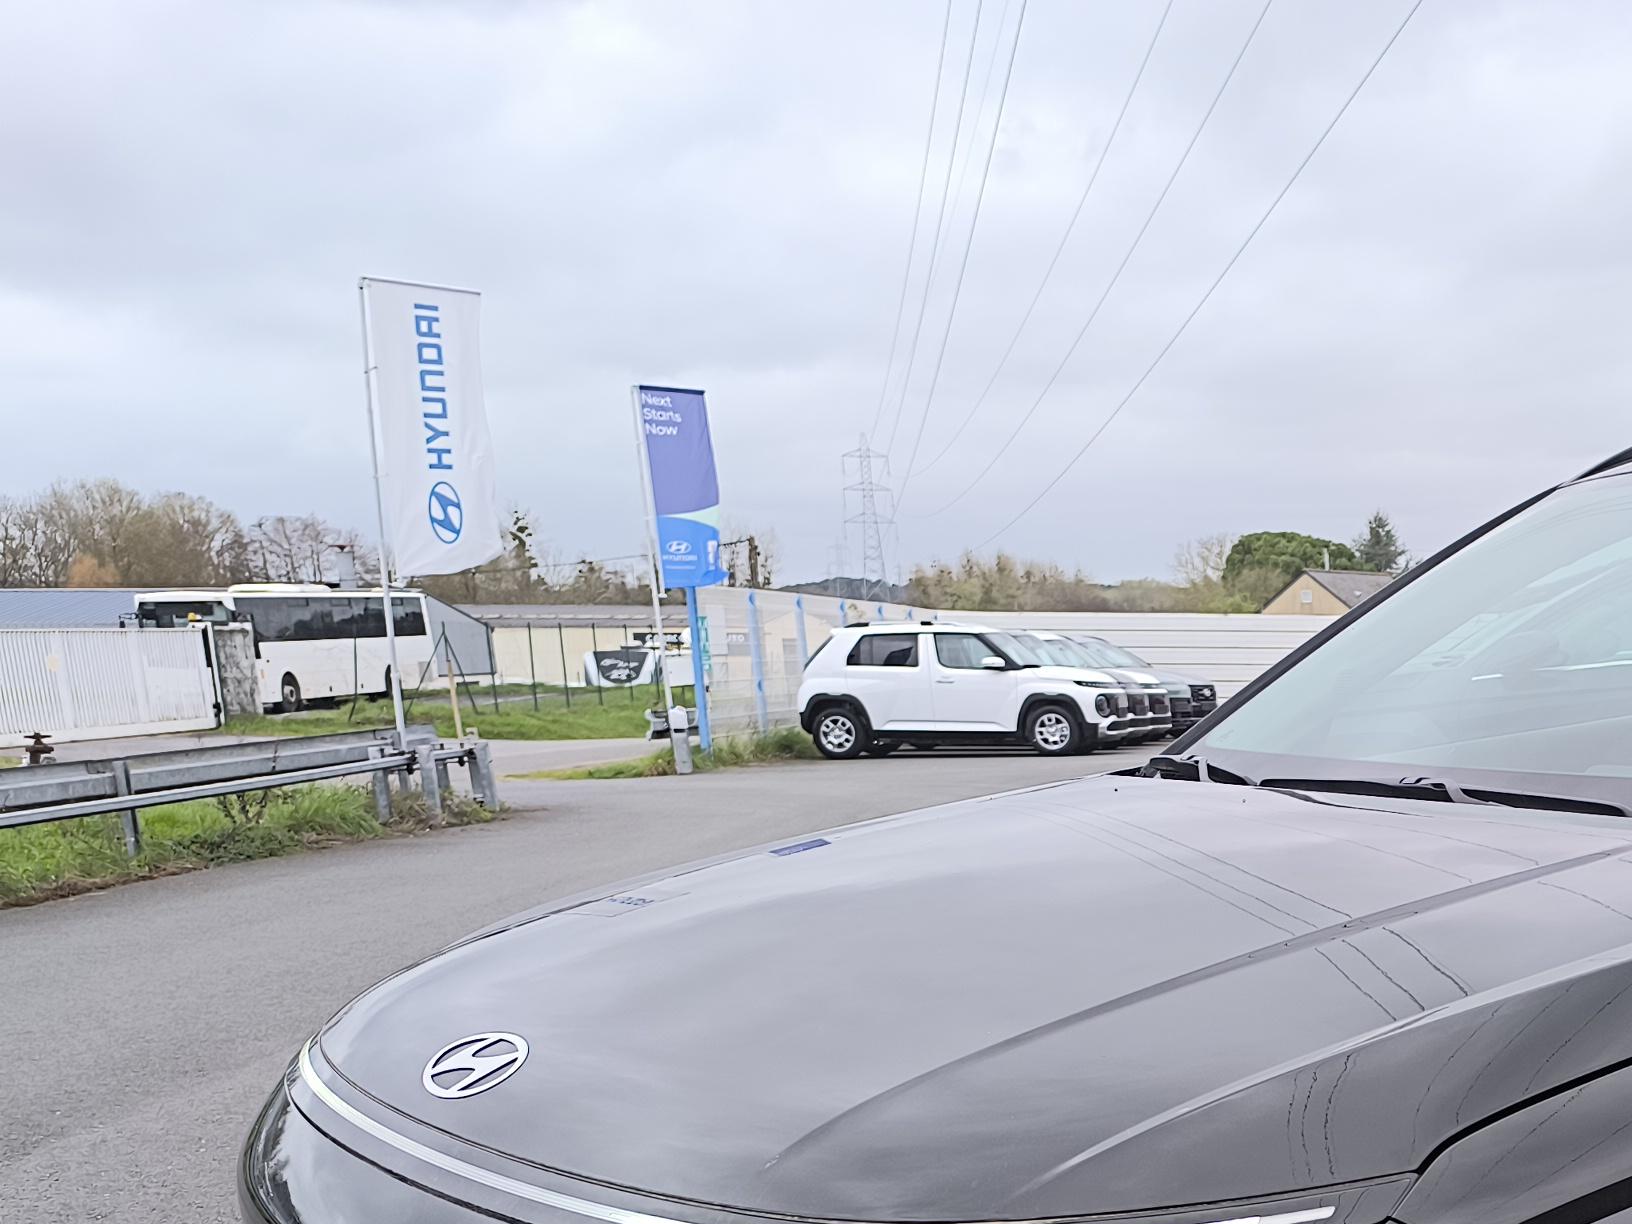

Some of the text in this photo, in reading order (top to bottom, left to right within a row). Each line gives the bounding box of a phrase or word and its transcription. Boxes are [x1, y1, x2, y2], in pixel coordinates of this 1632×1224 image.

[414, 303, 453, 470] HYUNDAI
[641, 393, 672, 408] Next
[643, 408, 682, 423] Starts
[645, 422, 678, 436] Now
